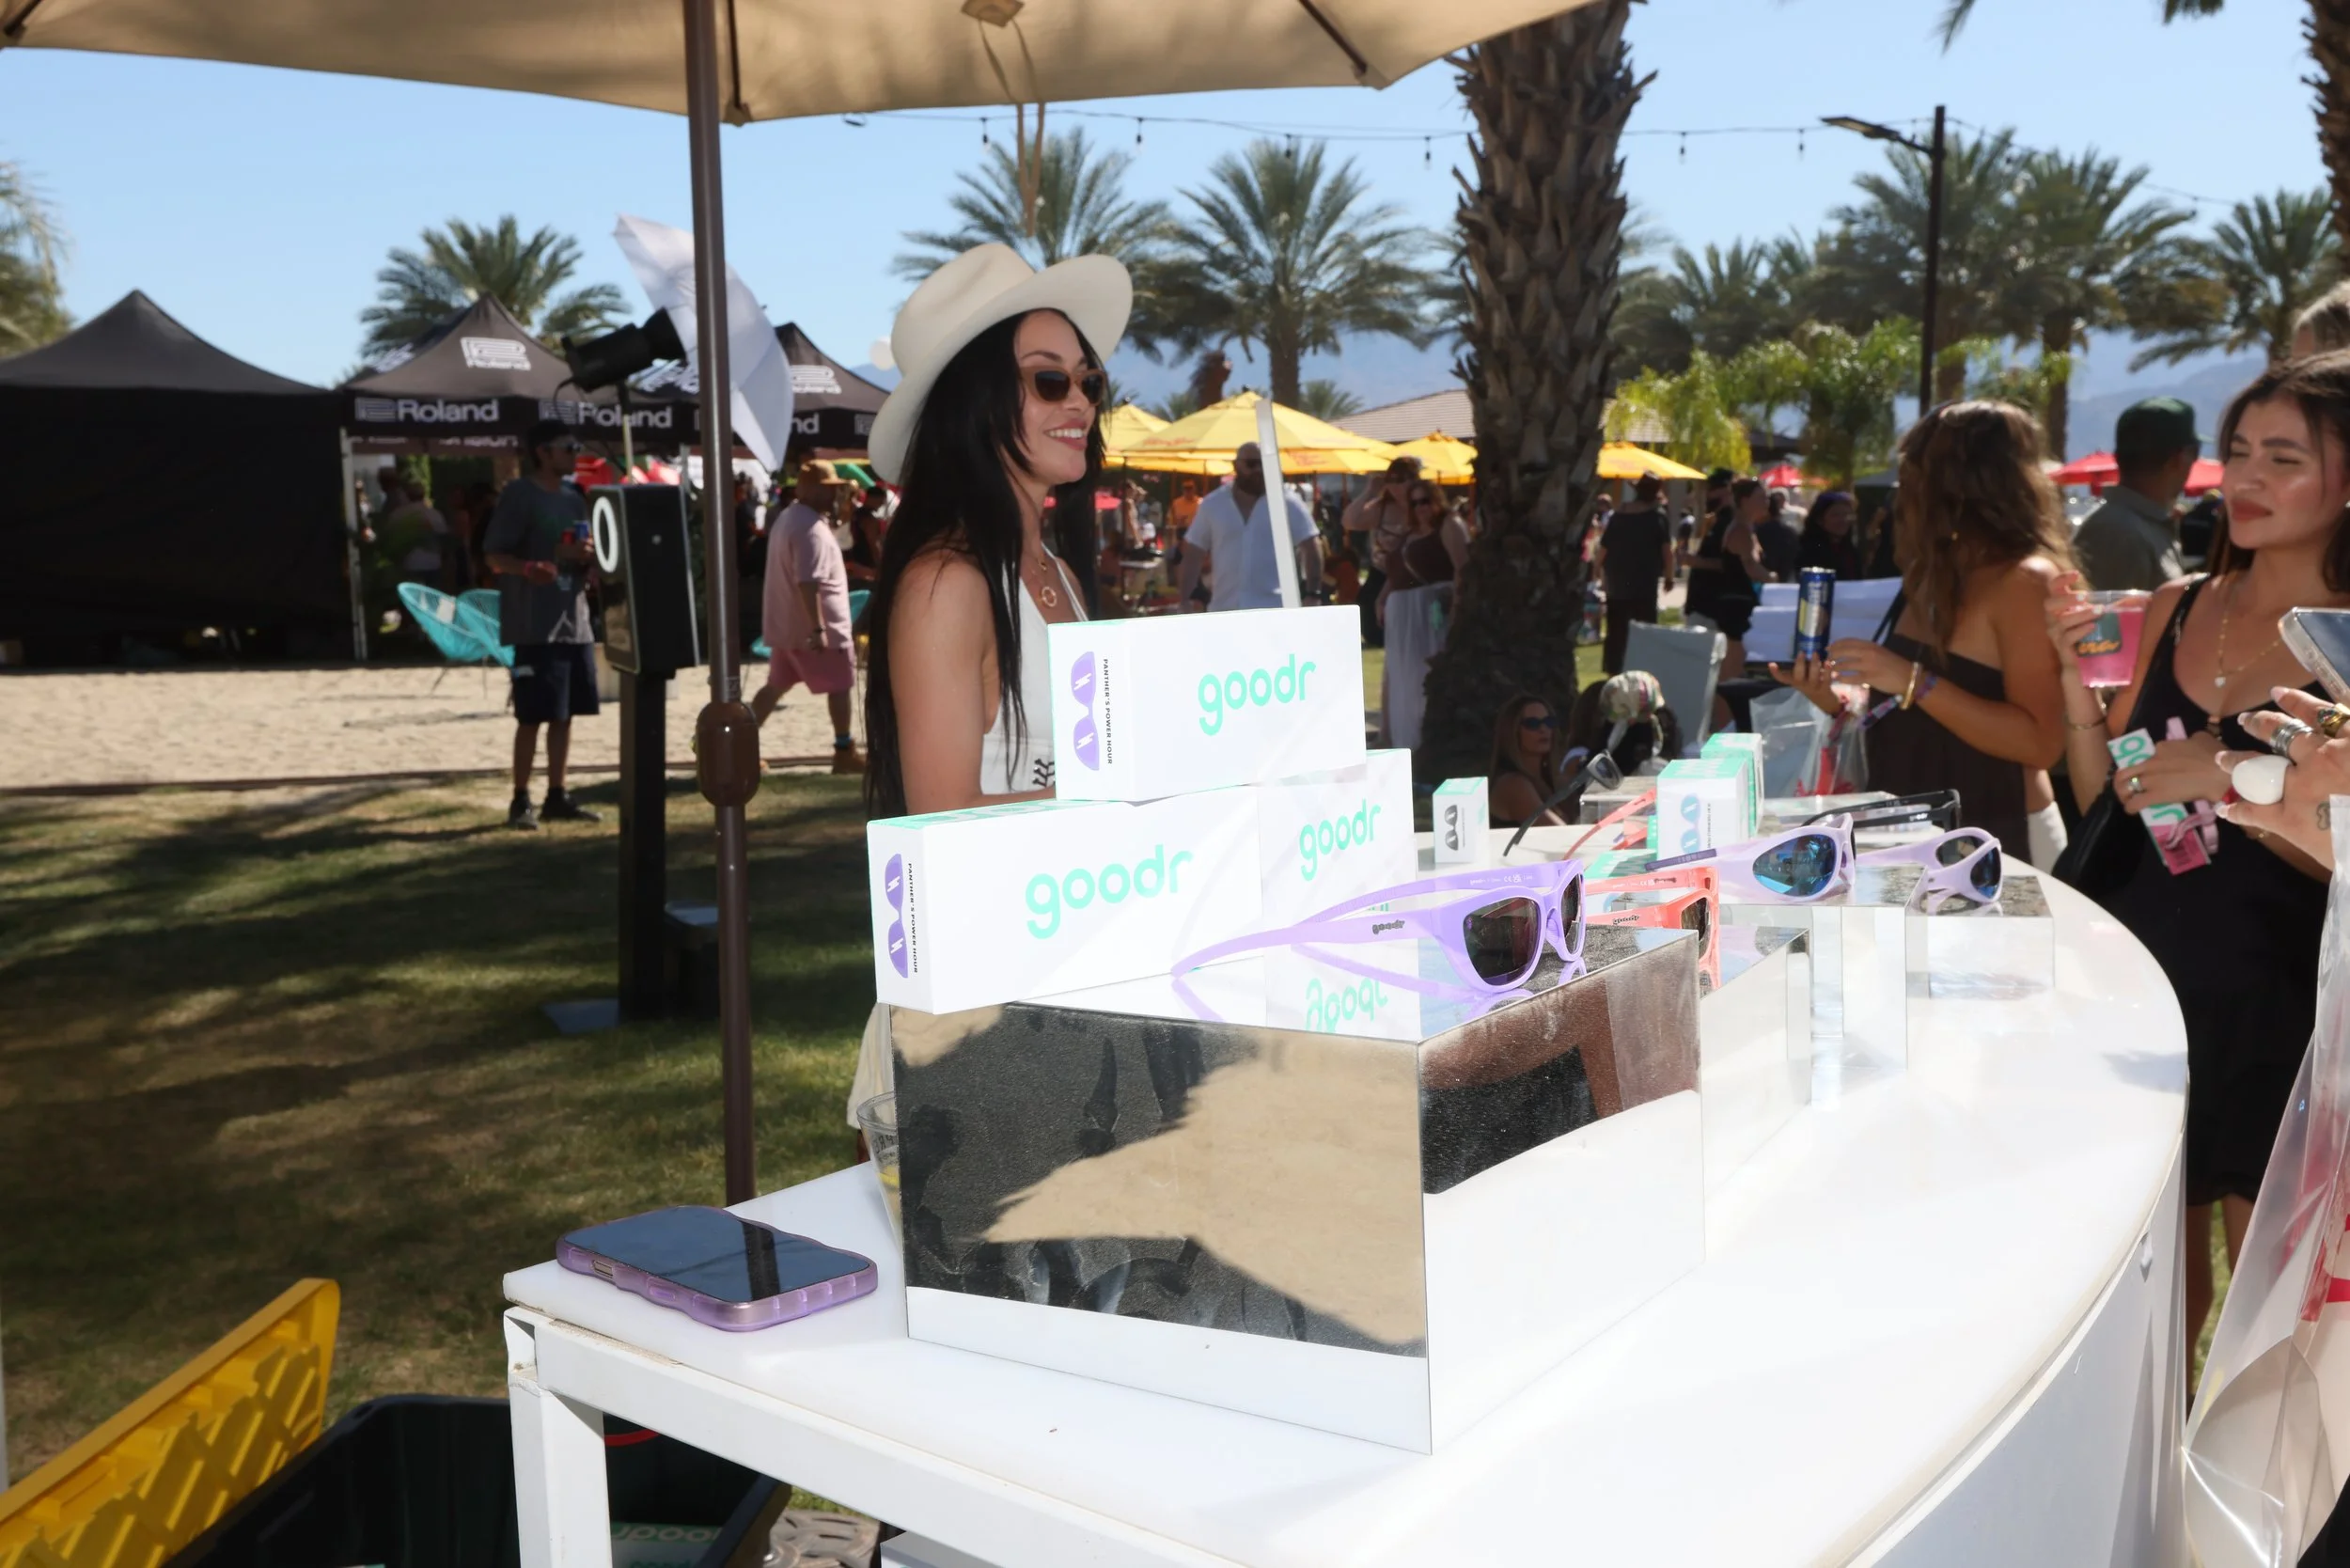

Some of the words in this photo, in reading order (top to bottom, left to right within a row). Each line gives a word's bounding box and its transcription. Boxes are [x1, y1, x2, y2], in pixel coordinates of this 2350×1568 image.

[397, 399, 499, 422] Roland
[1103, 658, 1111, 706] PANTHER'S
[1197, 652, 1317, 737] goodr
[1299, 798, 1382, 882] goodr
[1025, 843, 1194, 940] goodr
